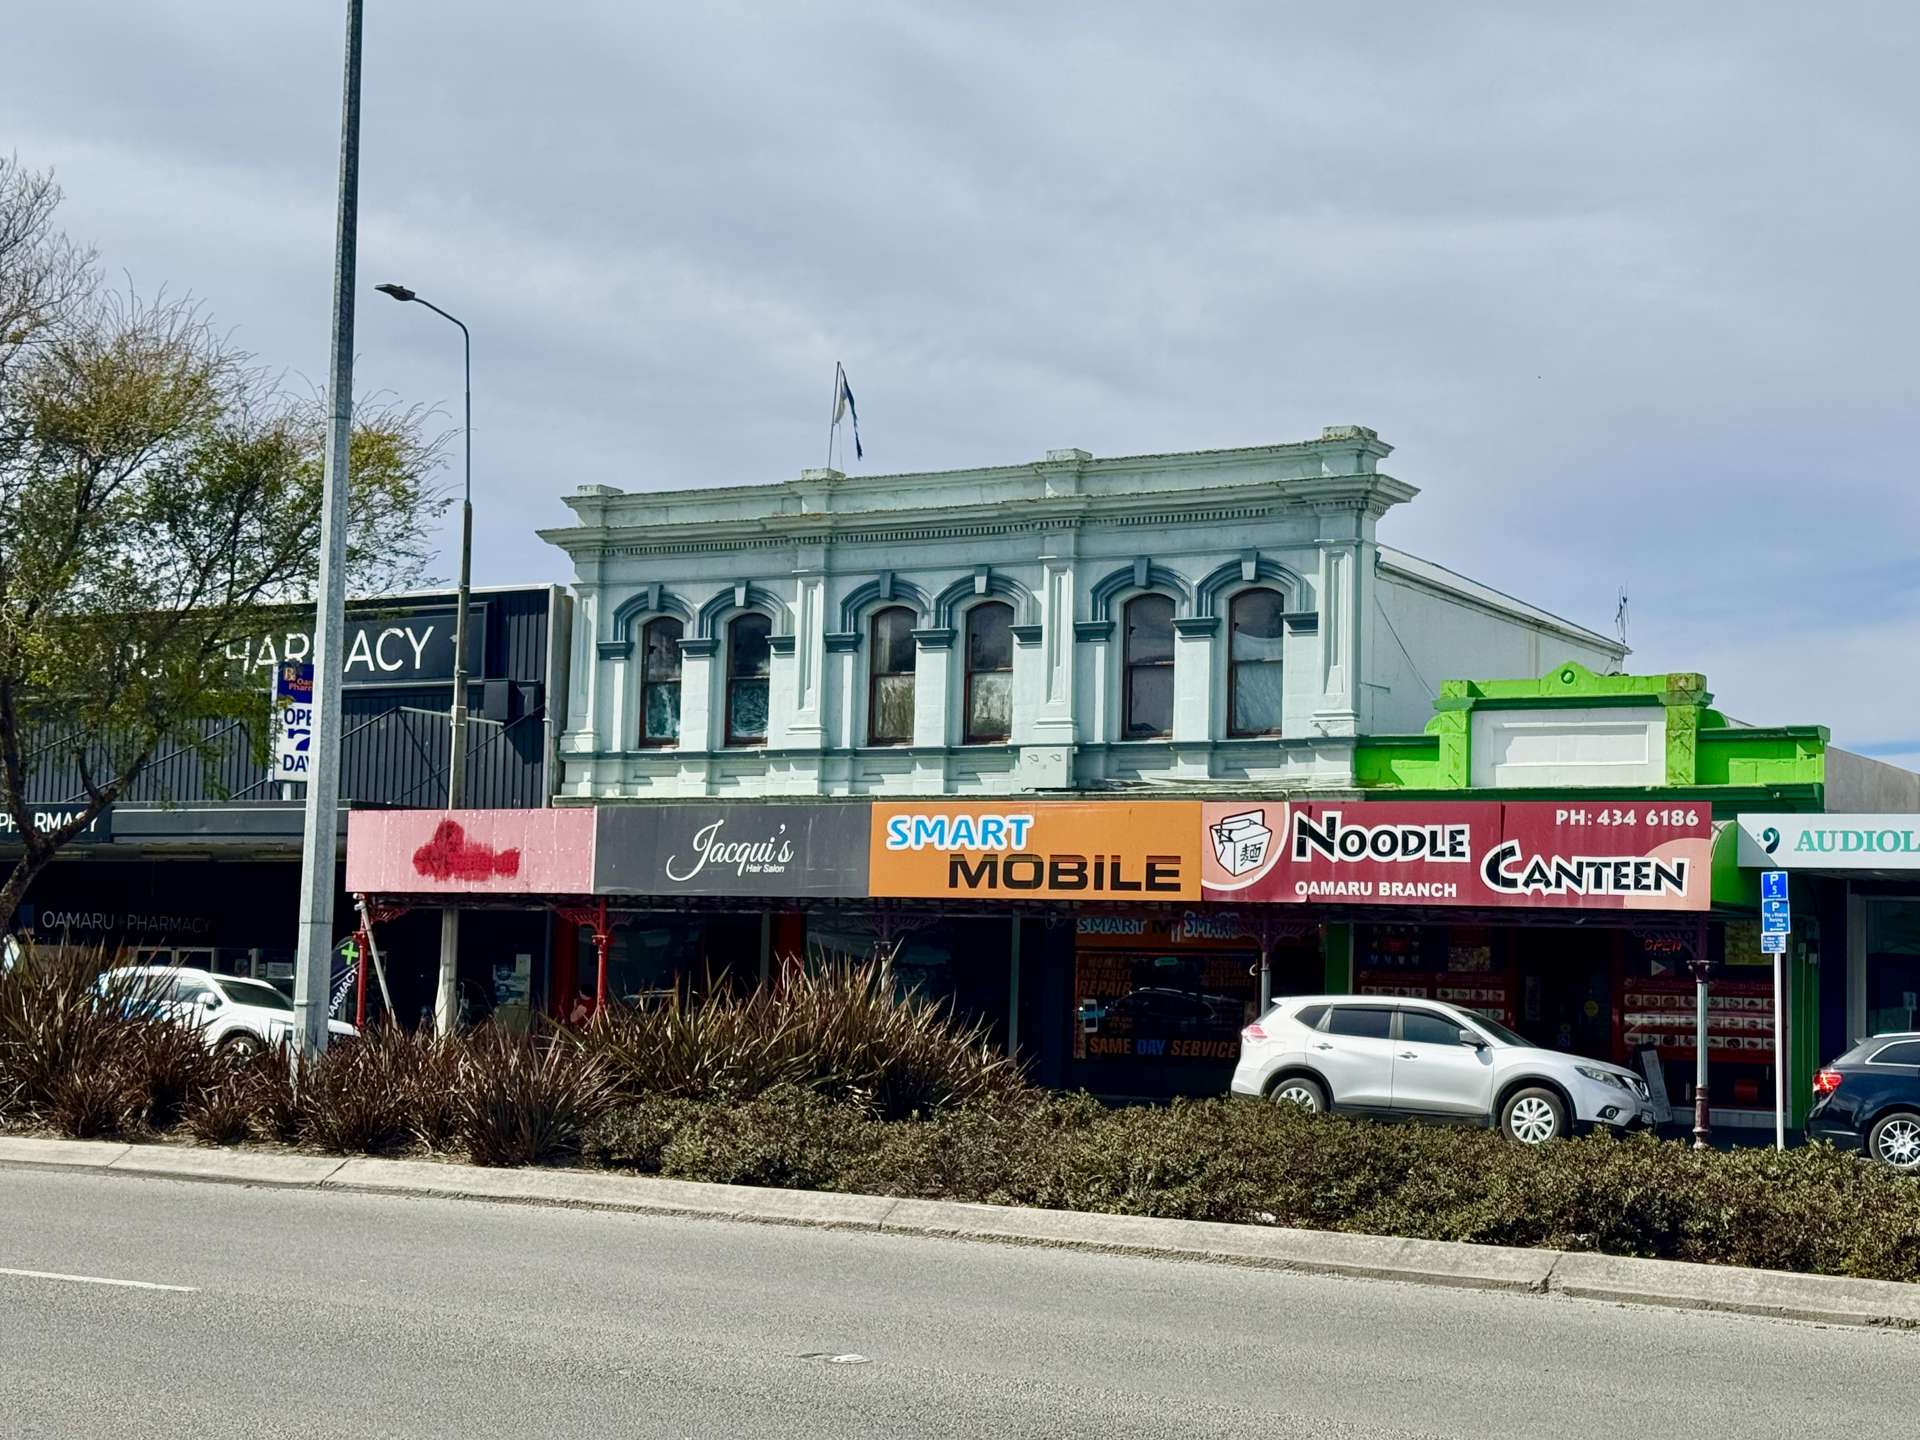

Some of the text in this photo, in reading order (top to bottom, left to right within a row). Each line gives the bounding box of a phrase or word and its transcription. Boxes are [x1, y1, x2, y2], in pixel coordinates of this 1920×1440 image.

[199, 626, 434, 678] HARACY
[284, 708, 312, 726] OPE
[1555, 809, 1699, 827] PH: 434 6186
[887, 814, 1034, 851] SMART
[665, 819, 794, 881] Jacqui's
[746, 864, 785, 873] Hair Salon
[948, 853, 1181, 892] MOBILE
[1770, 874, 1779, 886] P
[1295, 881, 1458, 898] OAMARU BRANCH
[1772, 901, 1780, 912] P
[42, 910, 211, 934] OAMARU PHARMACY
[1077, 916, 1147, 935] SMART
[1644, 938, 1682, 953] OPEN
[1089, 1037, 1239, 1058] SAME DAY SERVICE
